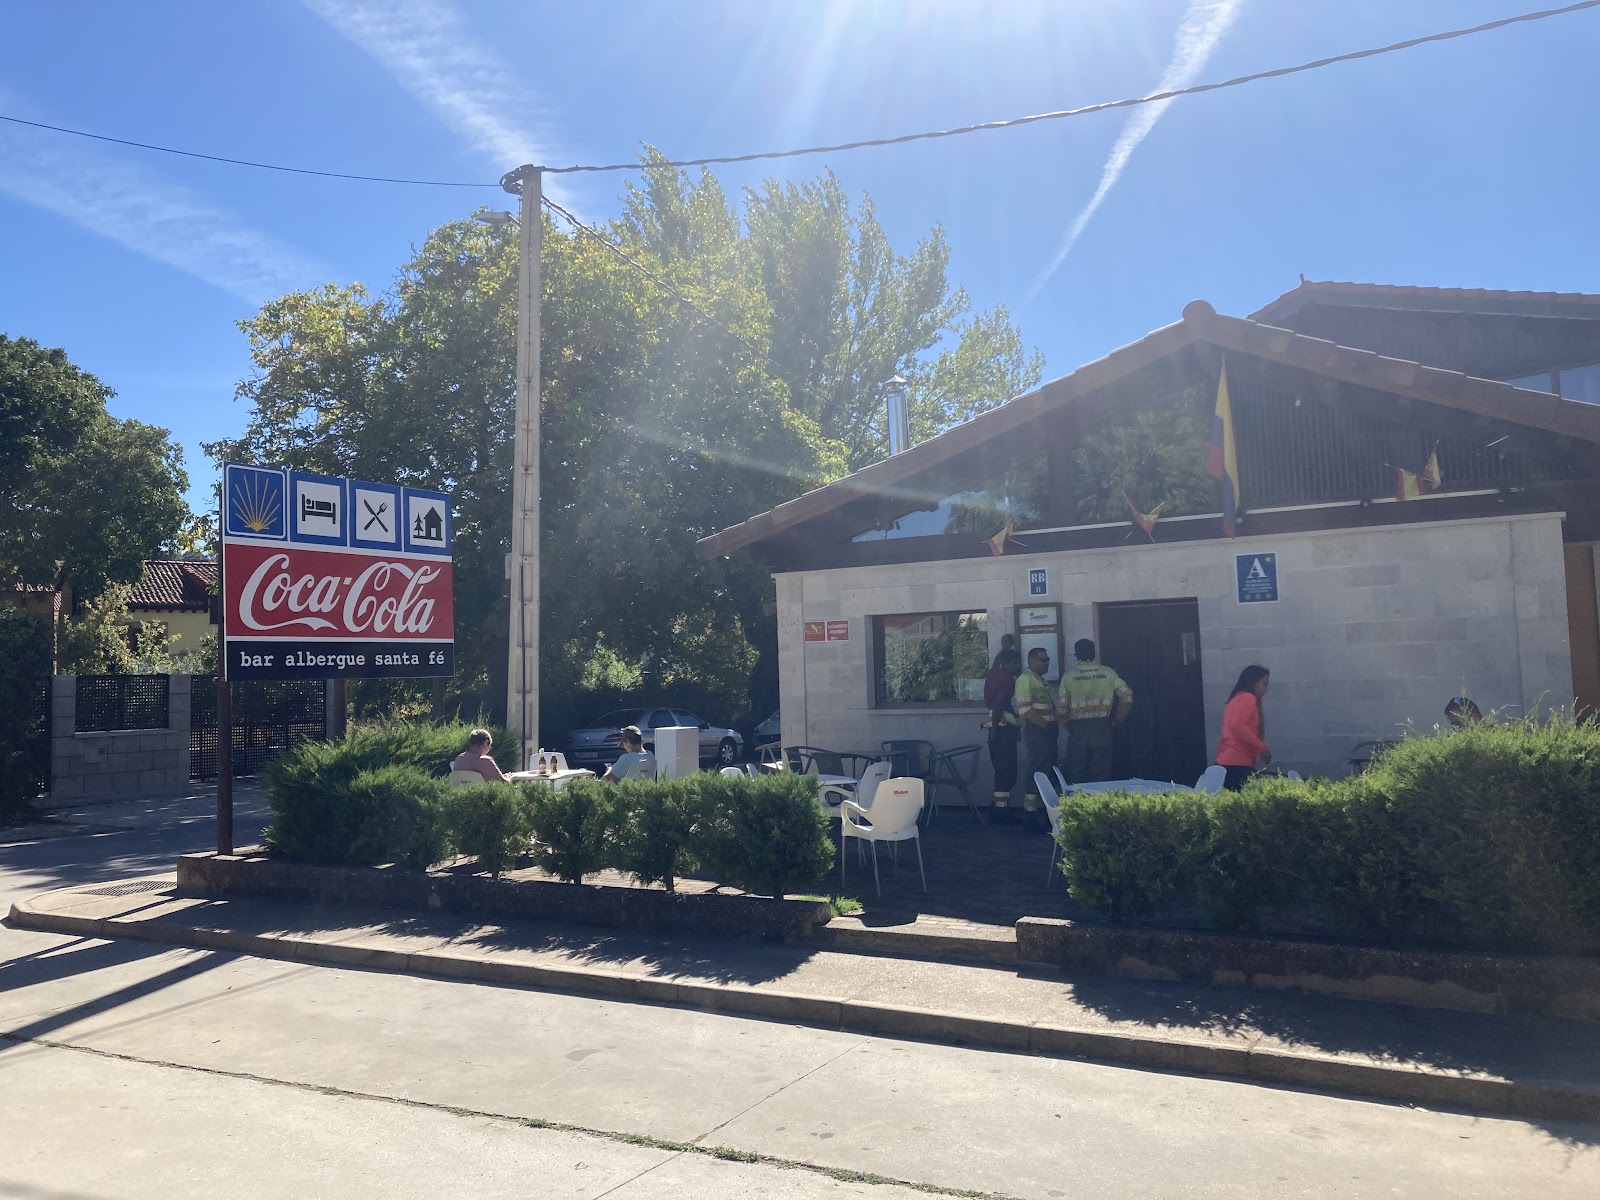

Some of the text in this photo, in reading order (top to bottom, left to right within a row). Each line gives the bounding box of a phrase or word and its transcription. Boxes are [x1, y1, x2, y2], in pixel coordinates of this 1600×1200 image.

[1031, 572, 1045, 583] RB
[1246, 557, 1268, 579] A
[239, 553, 442, 634] Coca-Cola
[240, 651, 445, 670] bar albergue santa fé
